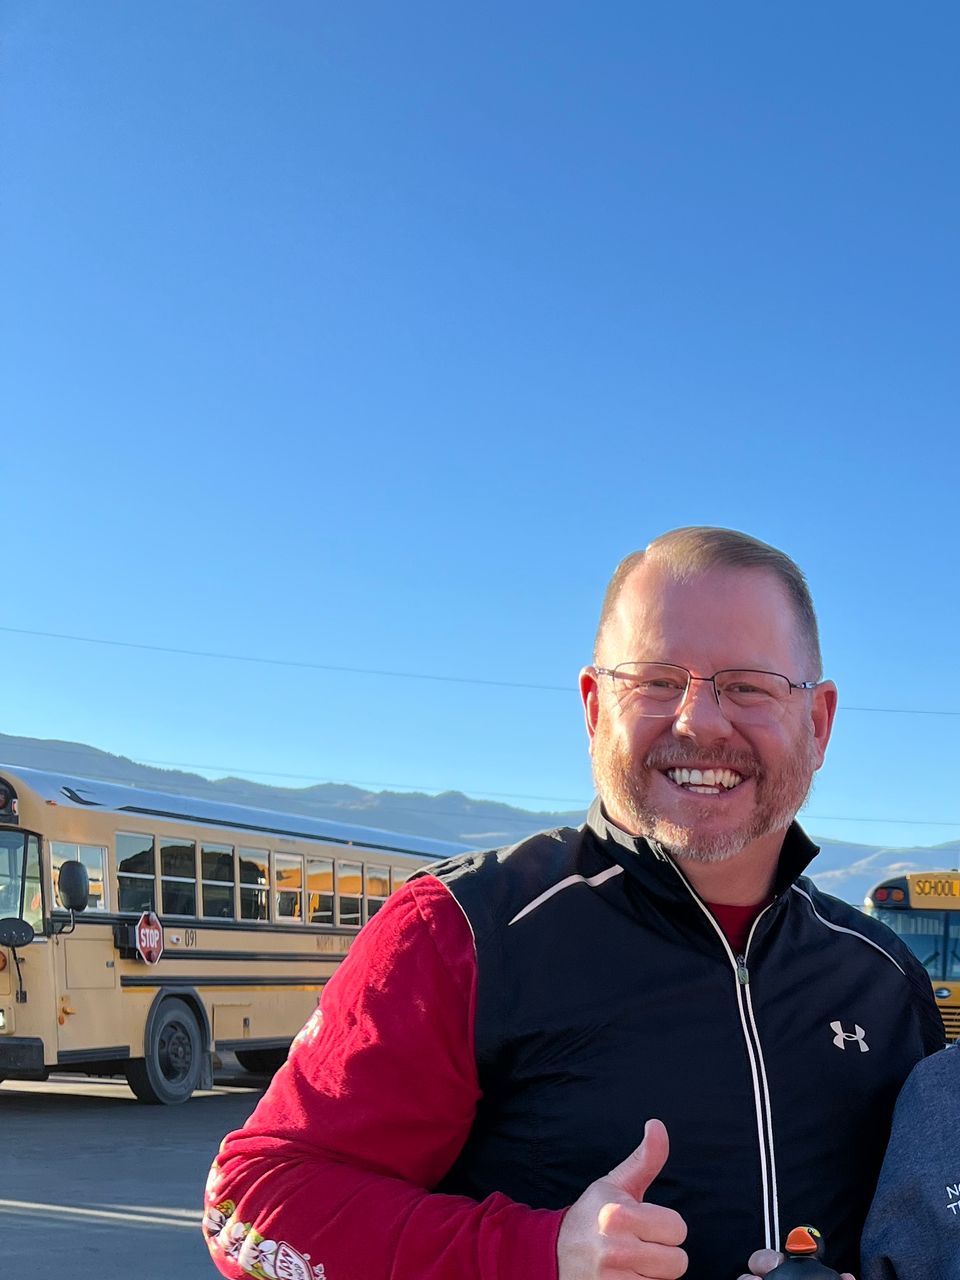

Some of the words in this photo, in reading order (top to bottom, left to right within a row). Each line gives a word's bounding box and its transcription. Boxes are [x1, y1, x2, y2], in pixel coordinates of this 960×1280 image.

[915, 880, 956, 896] SCHOOL
[140, 928, 160, 948] STOP
[184, 929, 197, 948] 091
